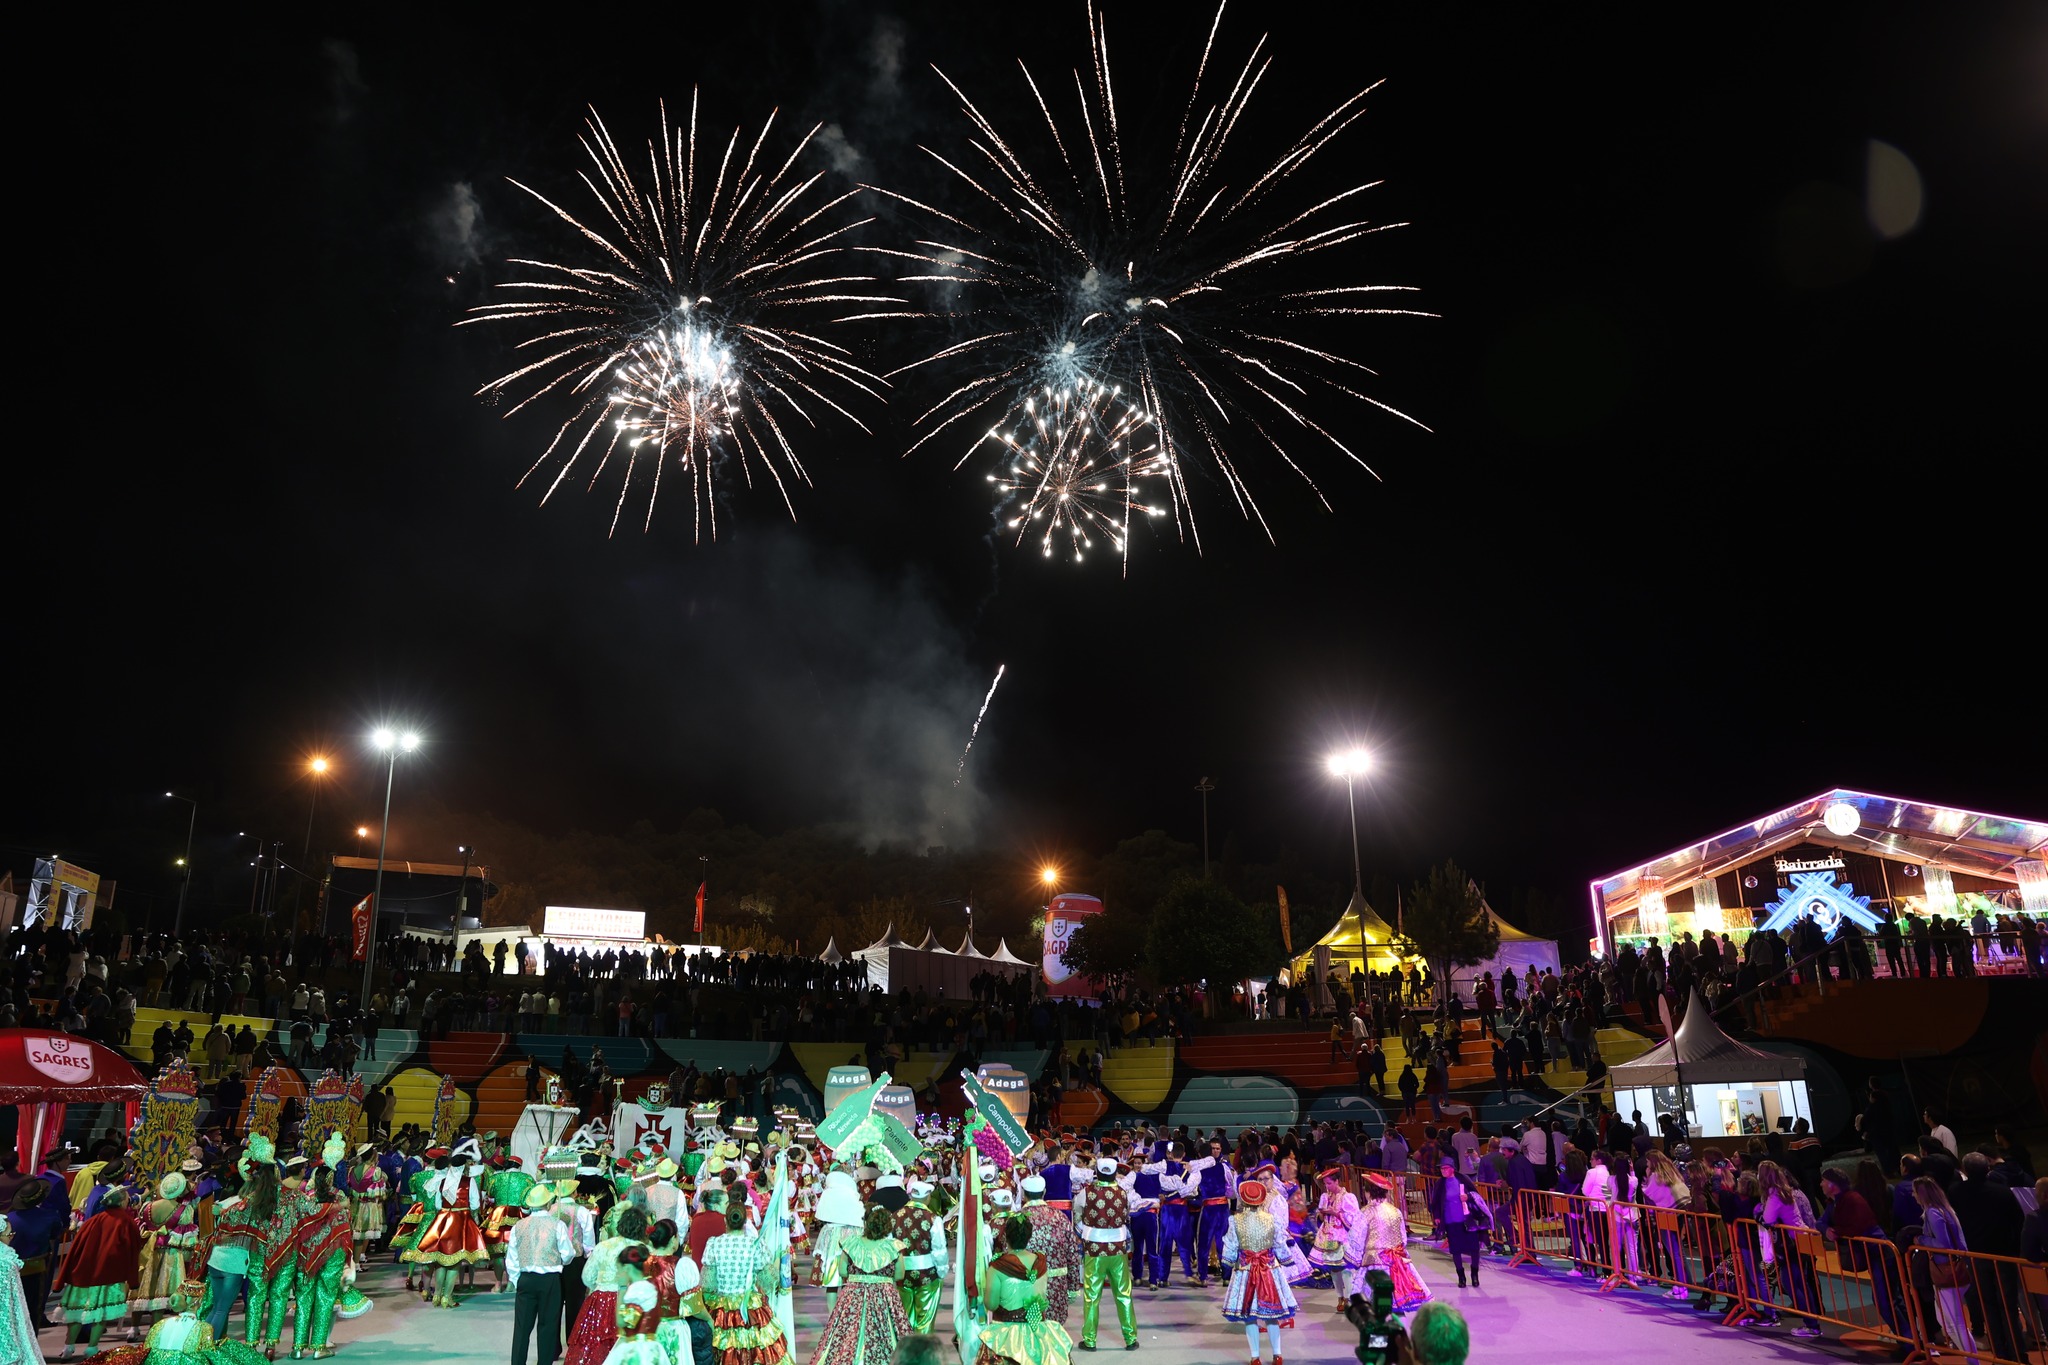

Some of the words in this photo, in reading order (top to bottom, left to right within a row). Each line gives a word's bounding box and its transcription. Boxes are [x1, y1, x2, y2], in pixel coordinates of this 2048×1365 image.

[1775, 855, 1844, 871] Bairrada
[1043, 940, 1067, 957] SAGR
[32, 1051, 90, 1070] SAGRES
[830, 1074, 866, 1084] Adega
[987, 1078, 1024, 1089] Adega
[877, 1094, 910, 1104] Adega
[836, 1112, 859, 1136] Almeida
[987, 1103, 1022, 1147] Campolargo
[885, 1126, 909, 1152] Parente
